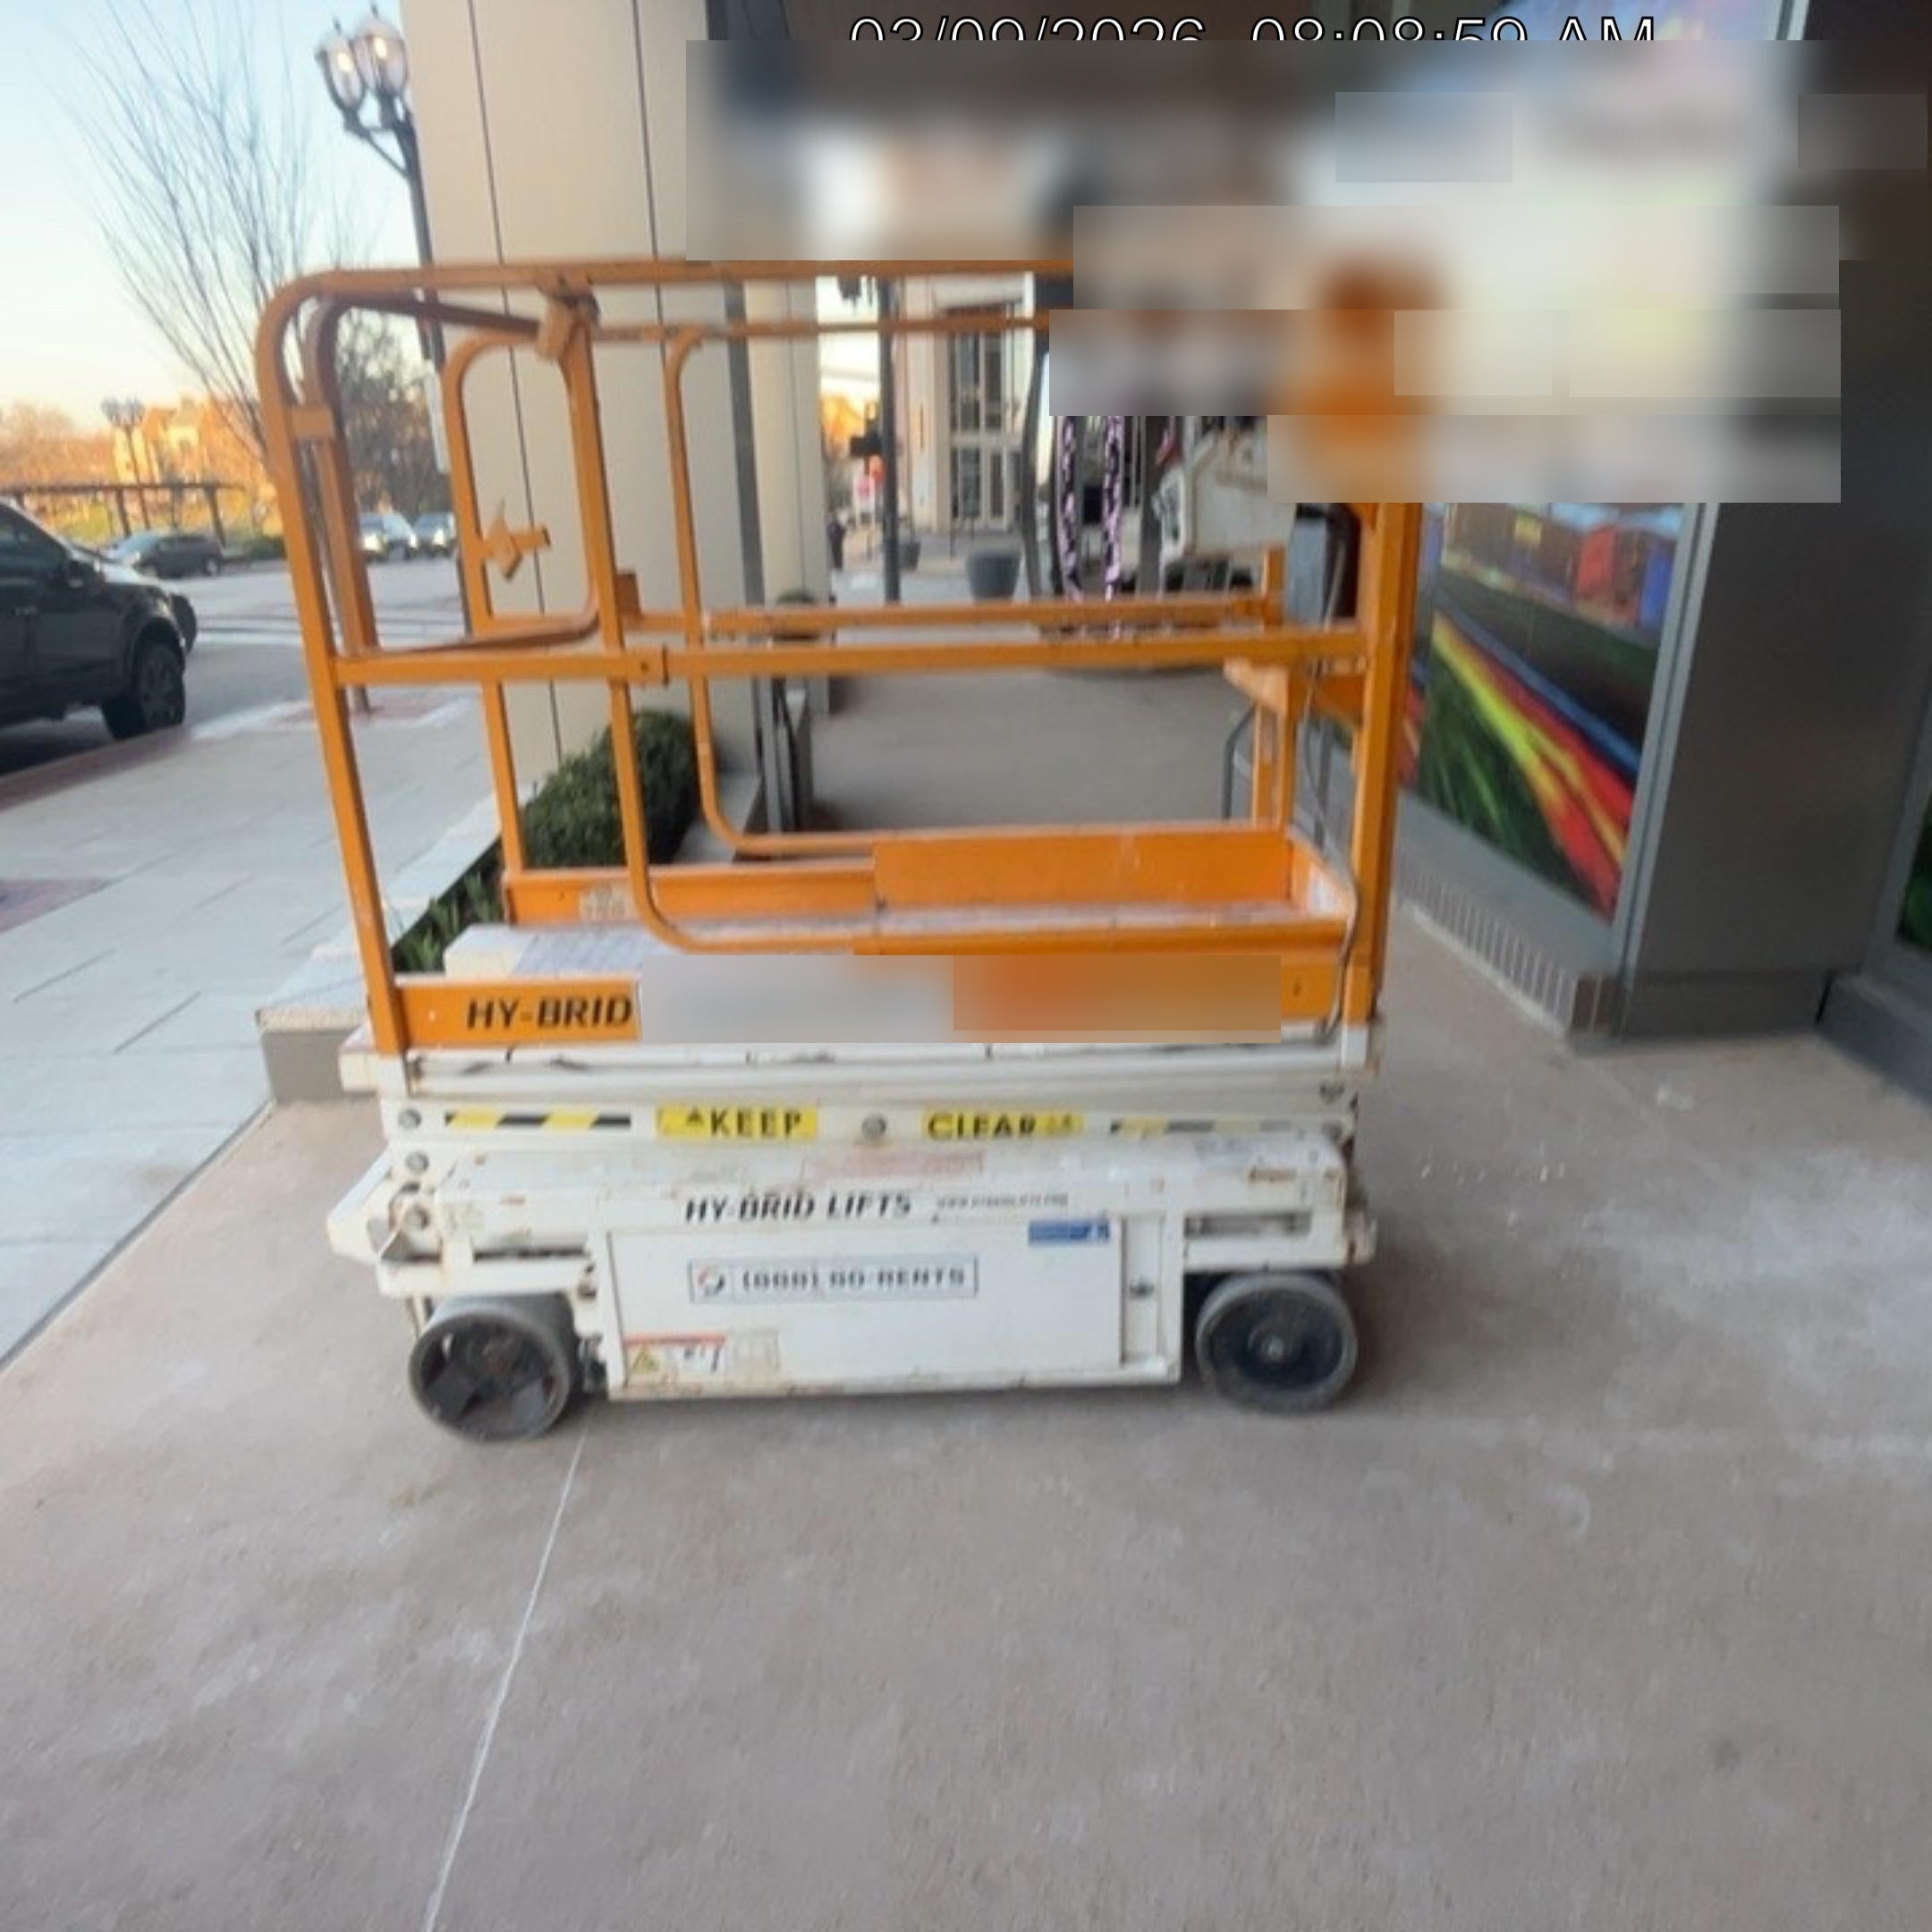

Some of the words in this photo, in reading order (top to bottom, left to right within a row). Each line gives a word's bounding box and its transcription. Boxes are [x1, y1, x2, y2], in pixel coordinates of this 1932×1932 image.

[467, 996, 632, 1030] HY-BRID
[711, 1109, 801, 1138] KEEP
[928, 1114, 1037, 1139] CLEAR
[827, 1191, 912, 1218] LIFTS
